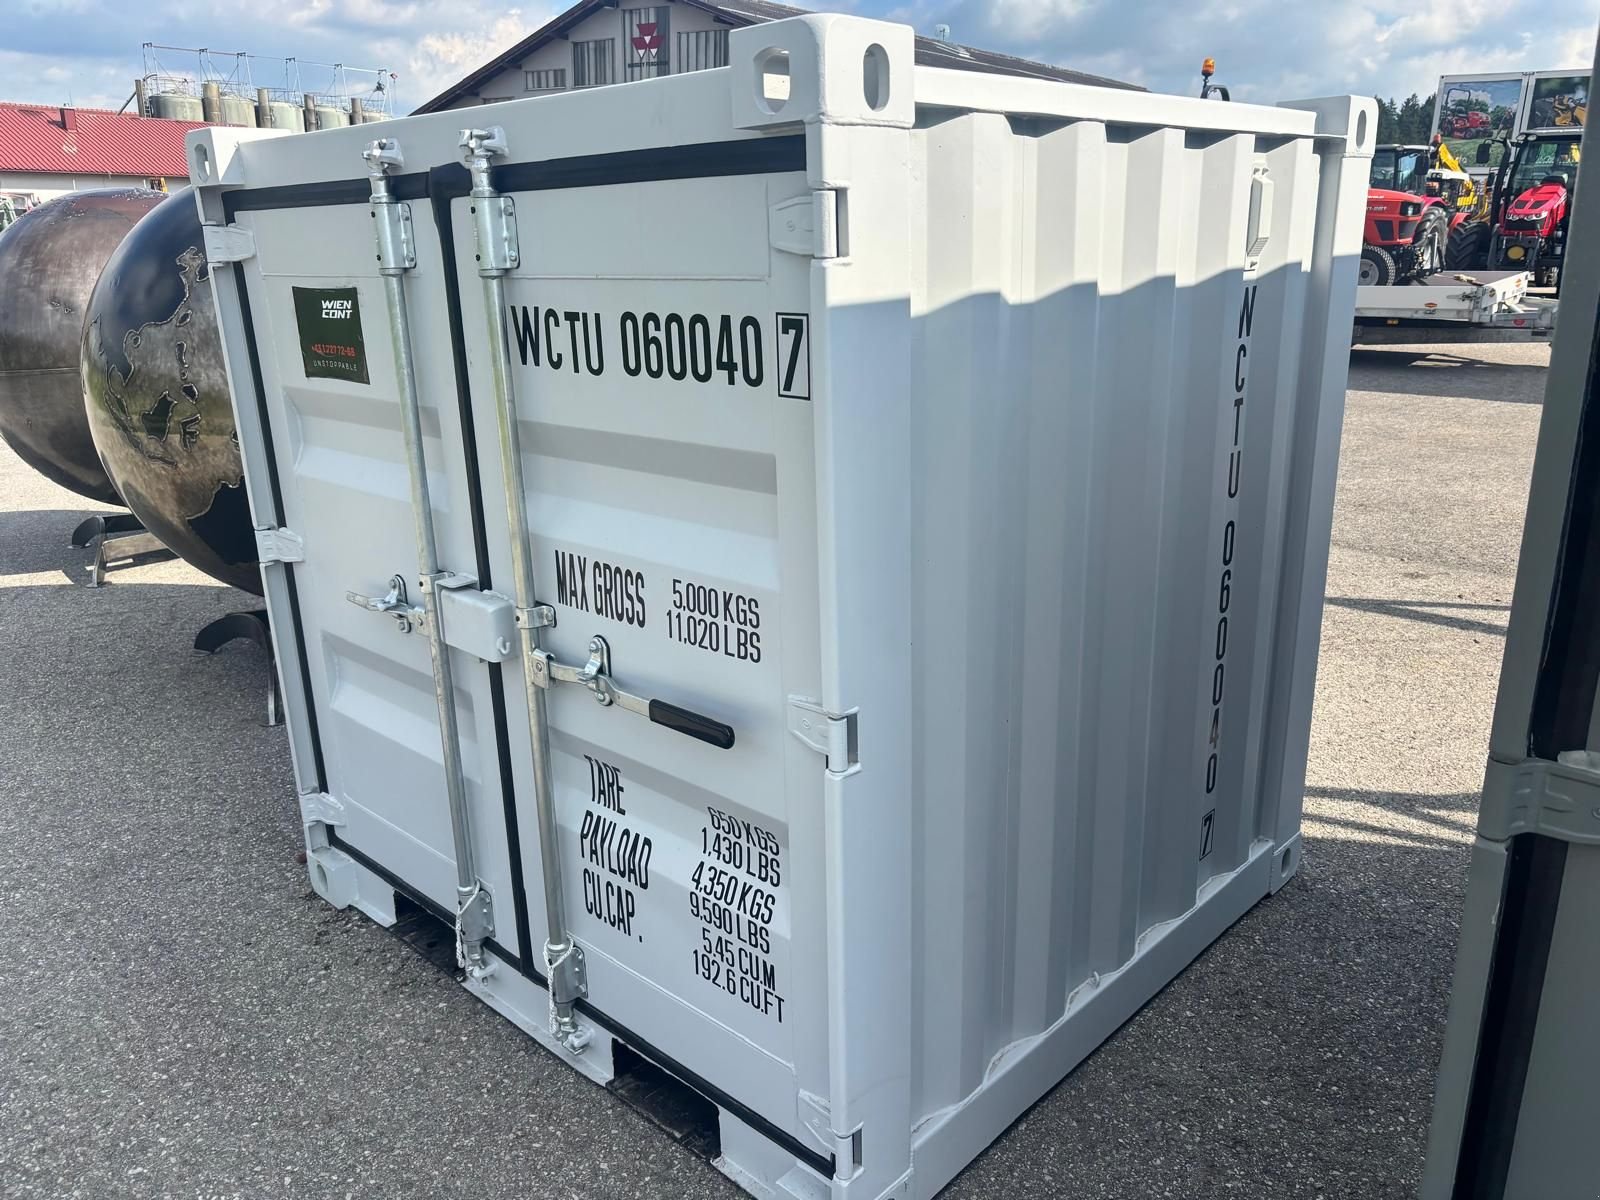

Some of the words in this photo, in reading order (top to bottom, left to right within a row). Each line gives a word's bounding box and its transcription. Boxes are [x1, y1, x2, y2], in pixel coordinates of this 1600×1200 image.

[321, 300, 352, 309] WIEN
[321, 310, 352, 319] CONT
[313, 360, 357, 371] UNSTOPPABLE
[510, 305, 604, 376] WCTU
[620, 311, 763, 388] 060040
[780, 317, 804, 392] 7
[555, 549, 589, 613] MAX
[593, 561, 646, 628] GROSS
[723, 591, 760, 629] KGS
[724, 624, 761, 663] LBS
[1206, 520, 1235, 794] 060040
[584, 754, 626, 816] TARE
[580, 810, 652, 890] PAYLOAD
[707, 806, 742, 839] 650
[741, 820, 779, 856] KGS
[746, 846, 781, 887] LBS
[737, 881, 776, 925] KGS
[736, 913, 770, 954] LBS
[702, 926, 735, 967] 5.45
[739, 947, 776, 991] CU.M
[693, 949, 736, 995] 192.6
[740, 976, 784, 1023] CU.FT
